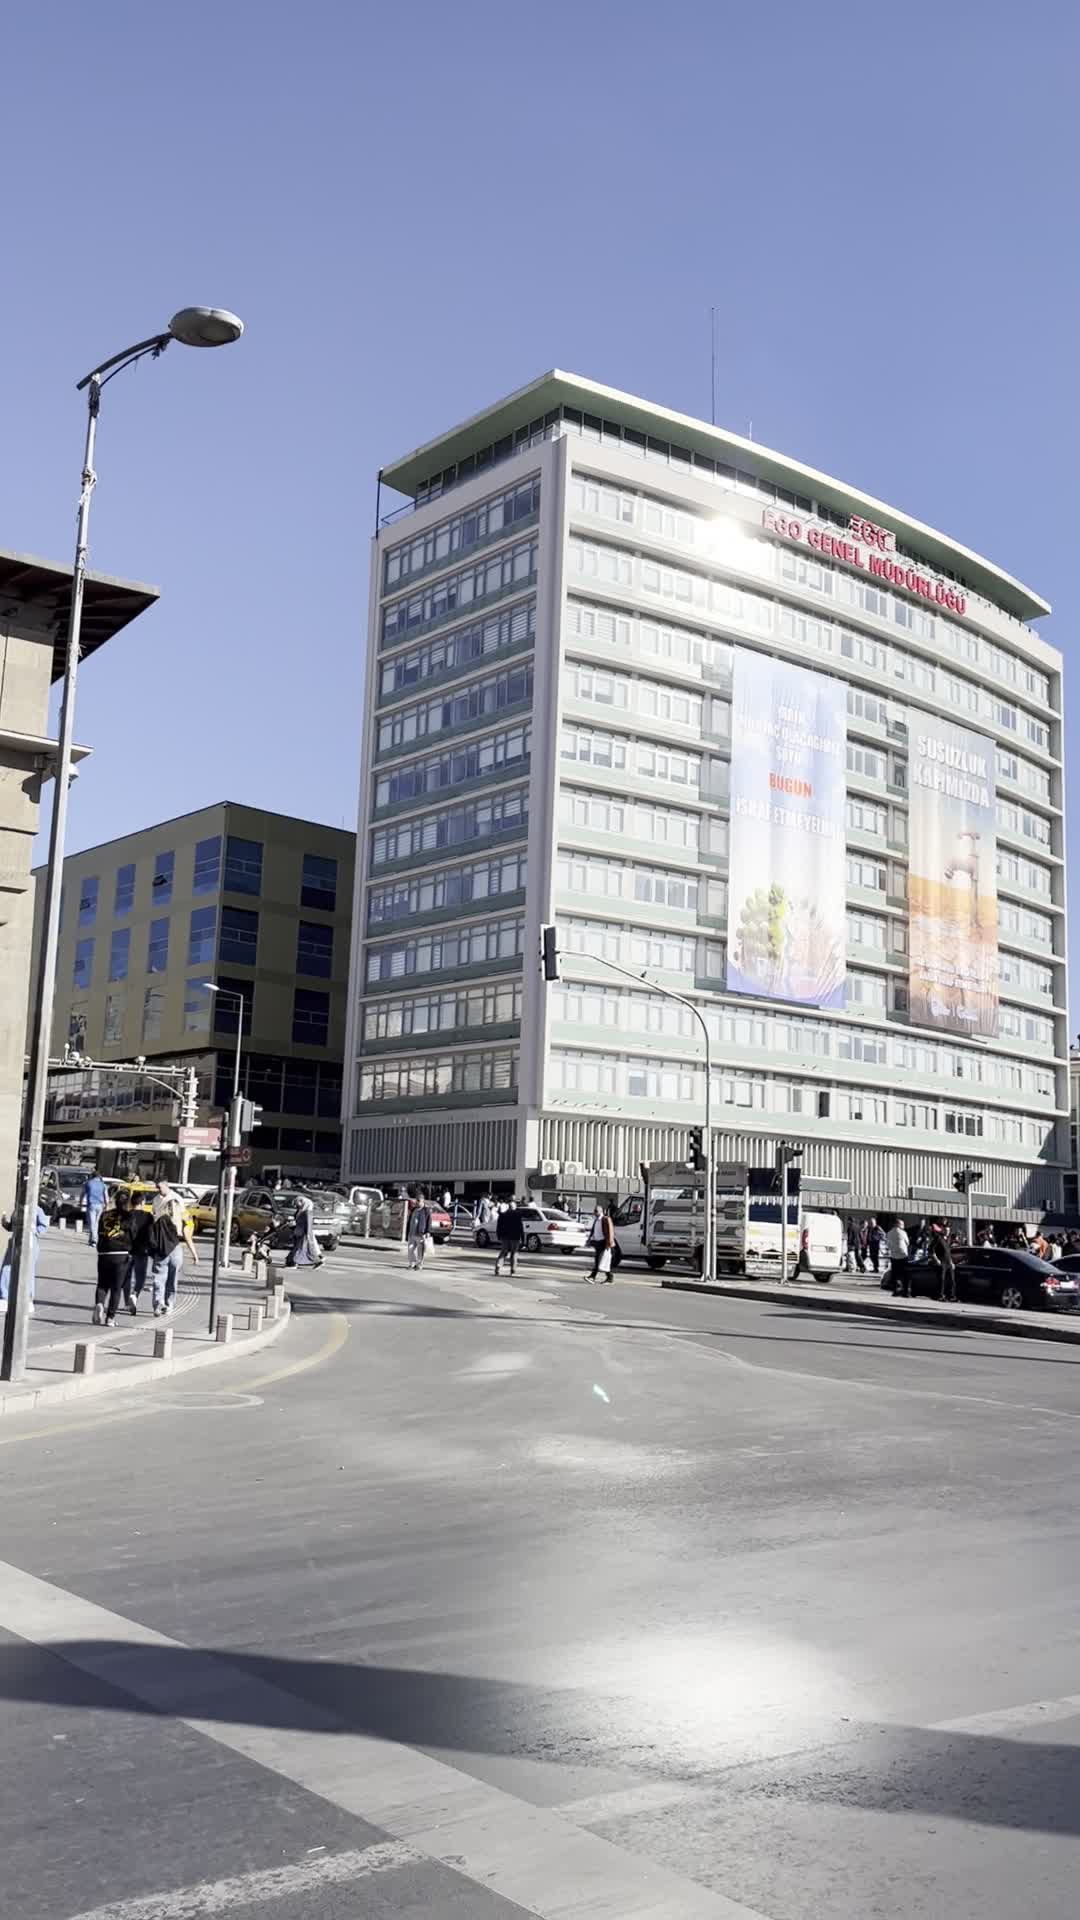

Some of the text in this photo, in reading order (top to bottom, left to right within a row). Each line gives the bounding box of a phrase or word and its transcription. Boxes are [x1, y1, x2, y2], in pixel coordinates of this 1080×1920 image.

[807, 528, 864, 568] GENEL
[869, 554, 966, 616] MÜDÜRLÜĞÜ
[918, 736, 986, 779] SUSUZLUK
[913, 761, 990, 808] KAPIMIZDA
